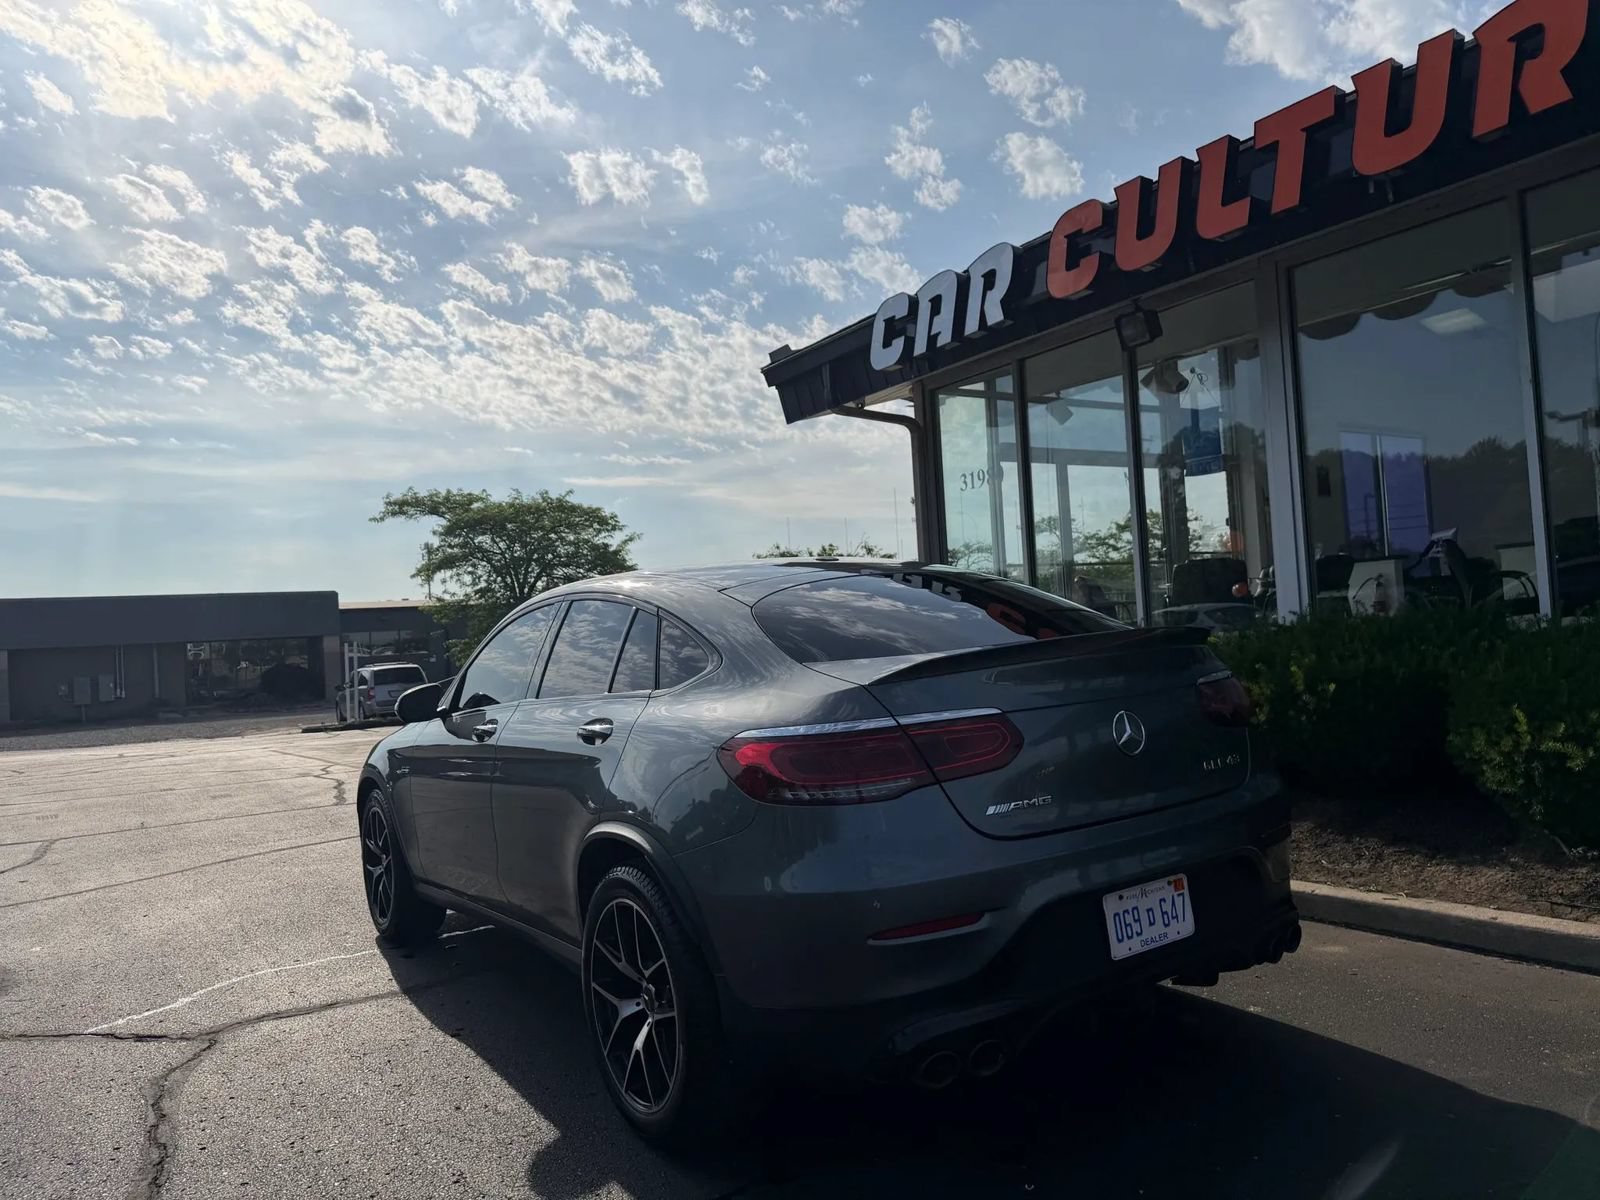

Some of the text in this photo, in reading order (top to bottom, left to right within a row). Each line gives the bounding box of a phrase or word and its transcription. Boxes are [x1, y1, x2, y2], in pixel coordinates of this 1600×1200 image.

[870, 0, 1589, 371] CAR CULTUR
[1008, 795, 1052, 812] AMG
[1113, 906, 1143, 944] 069
[1146, 907, 1156, 927] D
[1159, 893, 1185, 928] 647
[1140, 932, 1168, 947] DEALER
